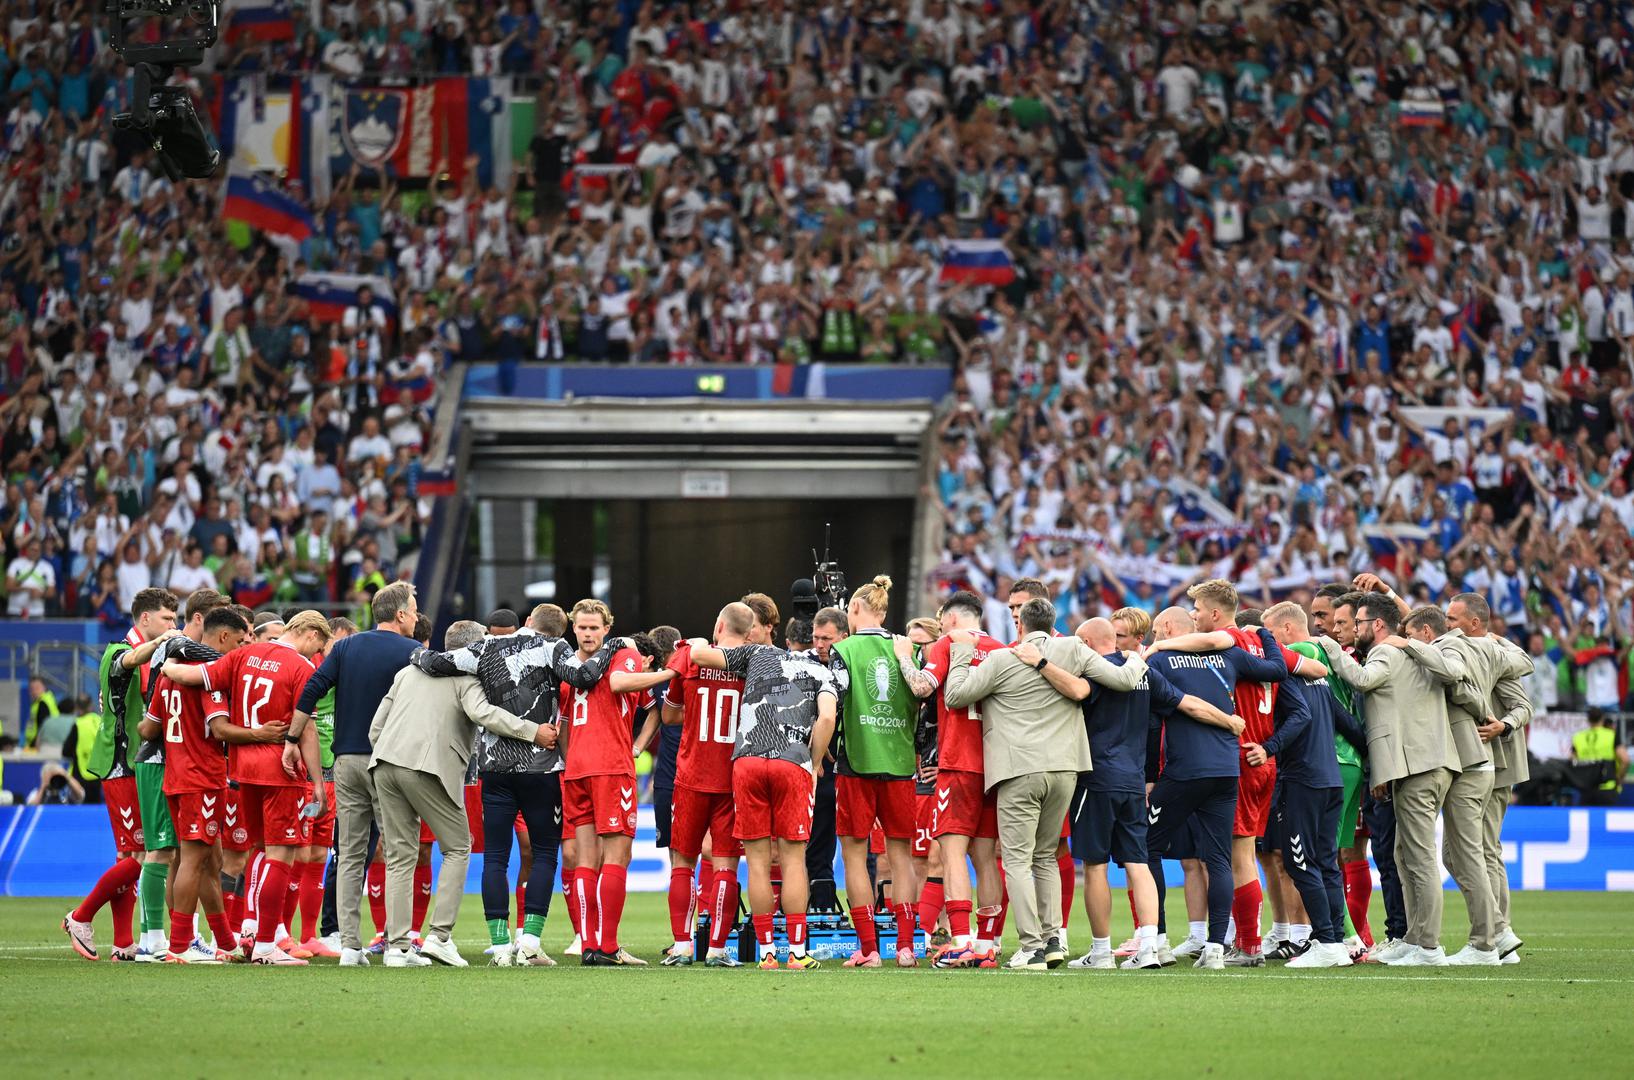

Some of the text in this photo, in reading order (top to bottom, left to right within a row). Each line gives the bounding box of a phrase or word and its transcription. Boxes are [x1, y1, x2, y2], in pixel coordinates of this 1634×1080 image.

[247, 656, 281, 673] DOLBERG
[1168, 655, 1226, 669] DANMARK
[700, 668, 738, 682] ERIKSEN
[242, 674, 274, 729] 12
[572, 687, 589, 727] 8
[871, 705, 893, 715] UEFA
[161, 689, 184, 743] 18
[697, 687, 740, 744] 10
[816, 943, 857, 951] POWERADE
